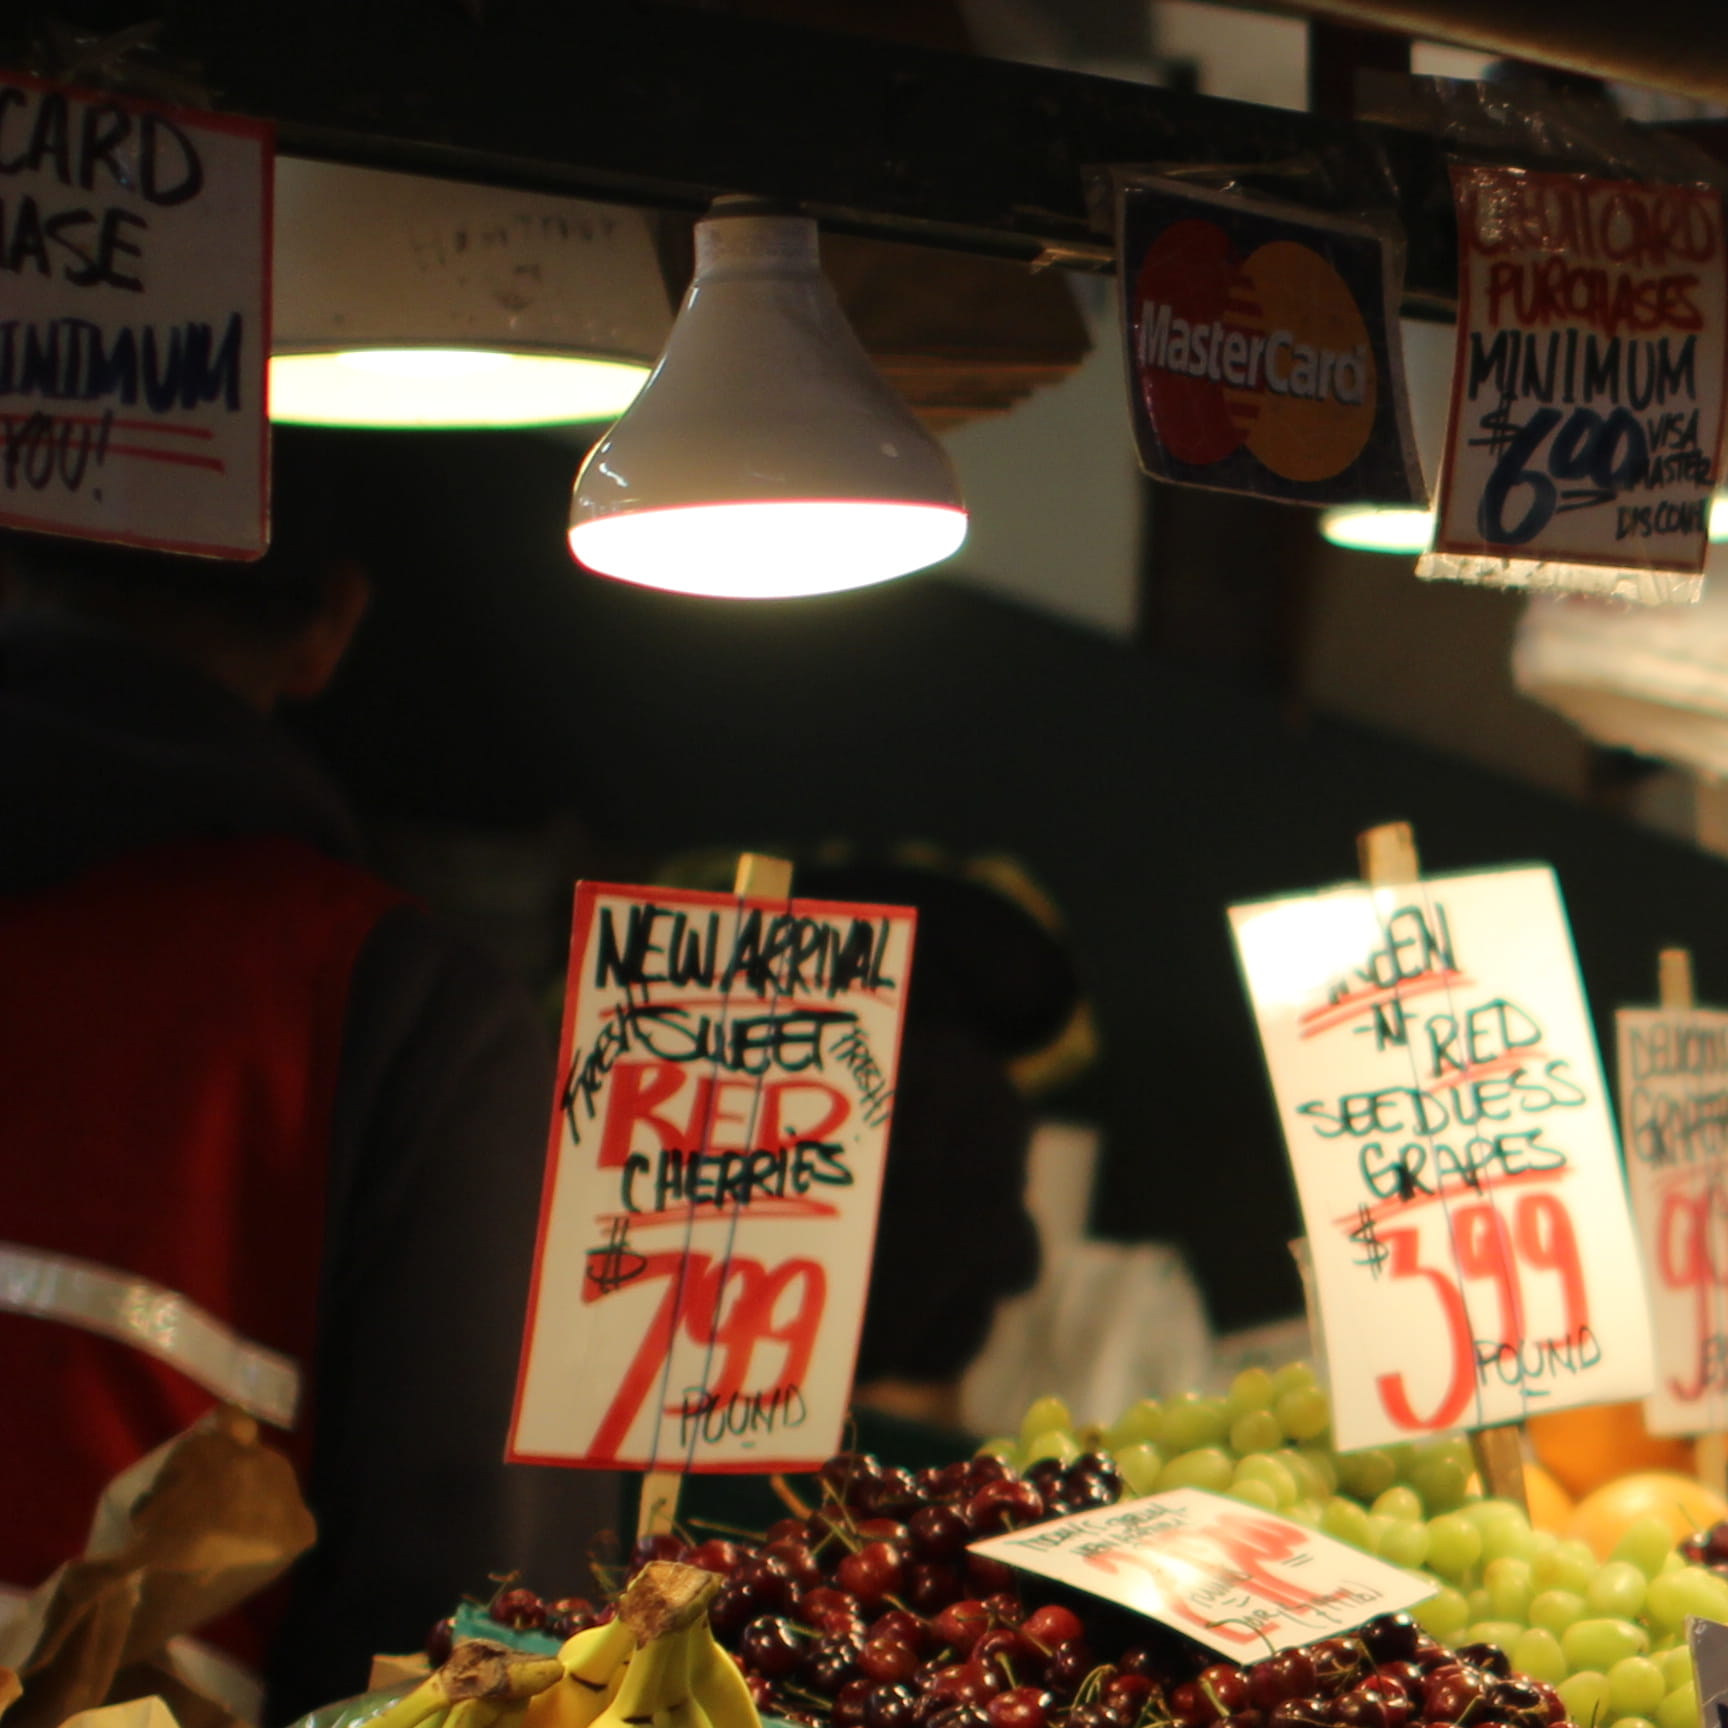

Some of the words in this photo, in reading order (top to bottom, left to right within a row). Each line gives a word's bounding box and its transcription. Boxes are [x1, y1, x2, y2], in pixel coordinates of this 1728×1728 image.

[1487, 254, 1704, 338] PURCHASES
[1137, 300, 1373, 405] MasterCard
[1468, 328, 1698, 411] MINIMUM
[1646, 407, 1699, 453] VISA
[596, 903, 719, 992] NEW
[716, 906, 897, 1000] ARRIVAL
[626, 1002, 860, 1077] SWEET
[1424, 998, 1542, 1078] RED
[597, 1062, 853, 1170] RED
[1296, 1060, 1586, 1138] SEEDLESS
[1358, 1127, 1568, 1201] GRAPES
[1474, 1324, 1603, 1386] POUND
[680, 1384, 807, 1448] POUND
